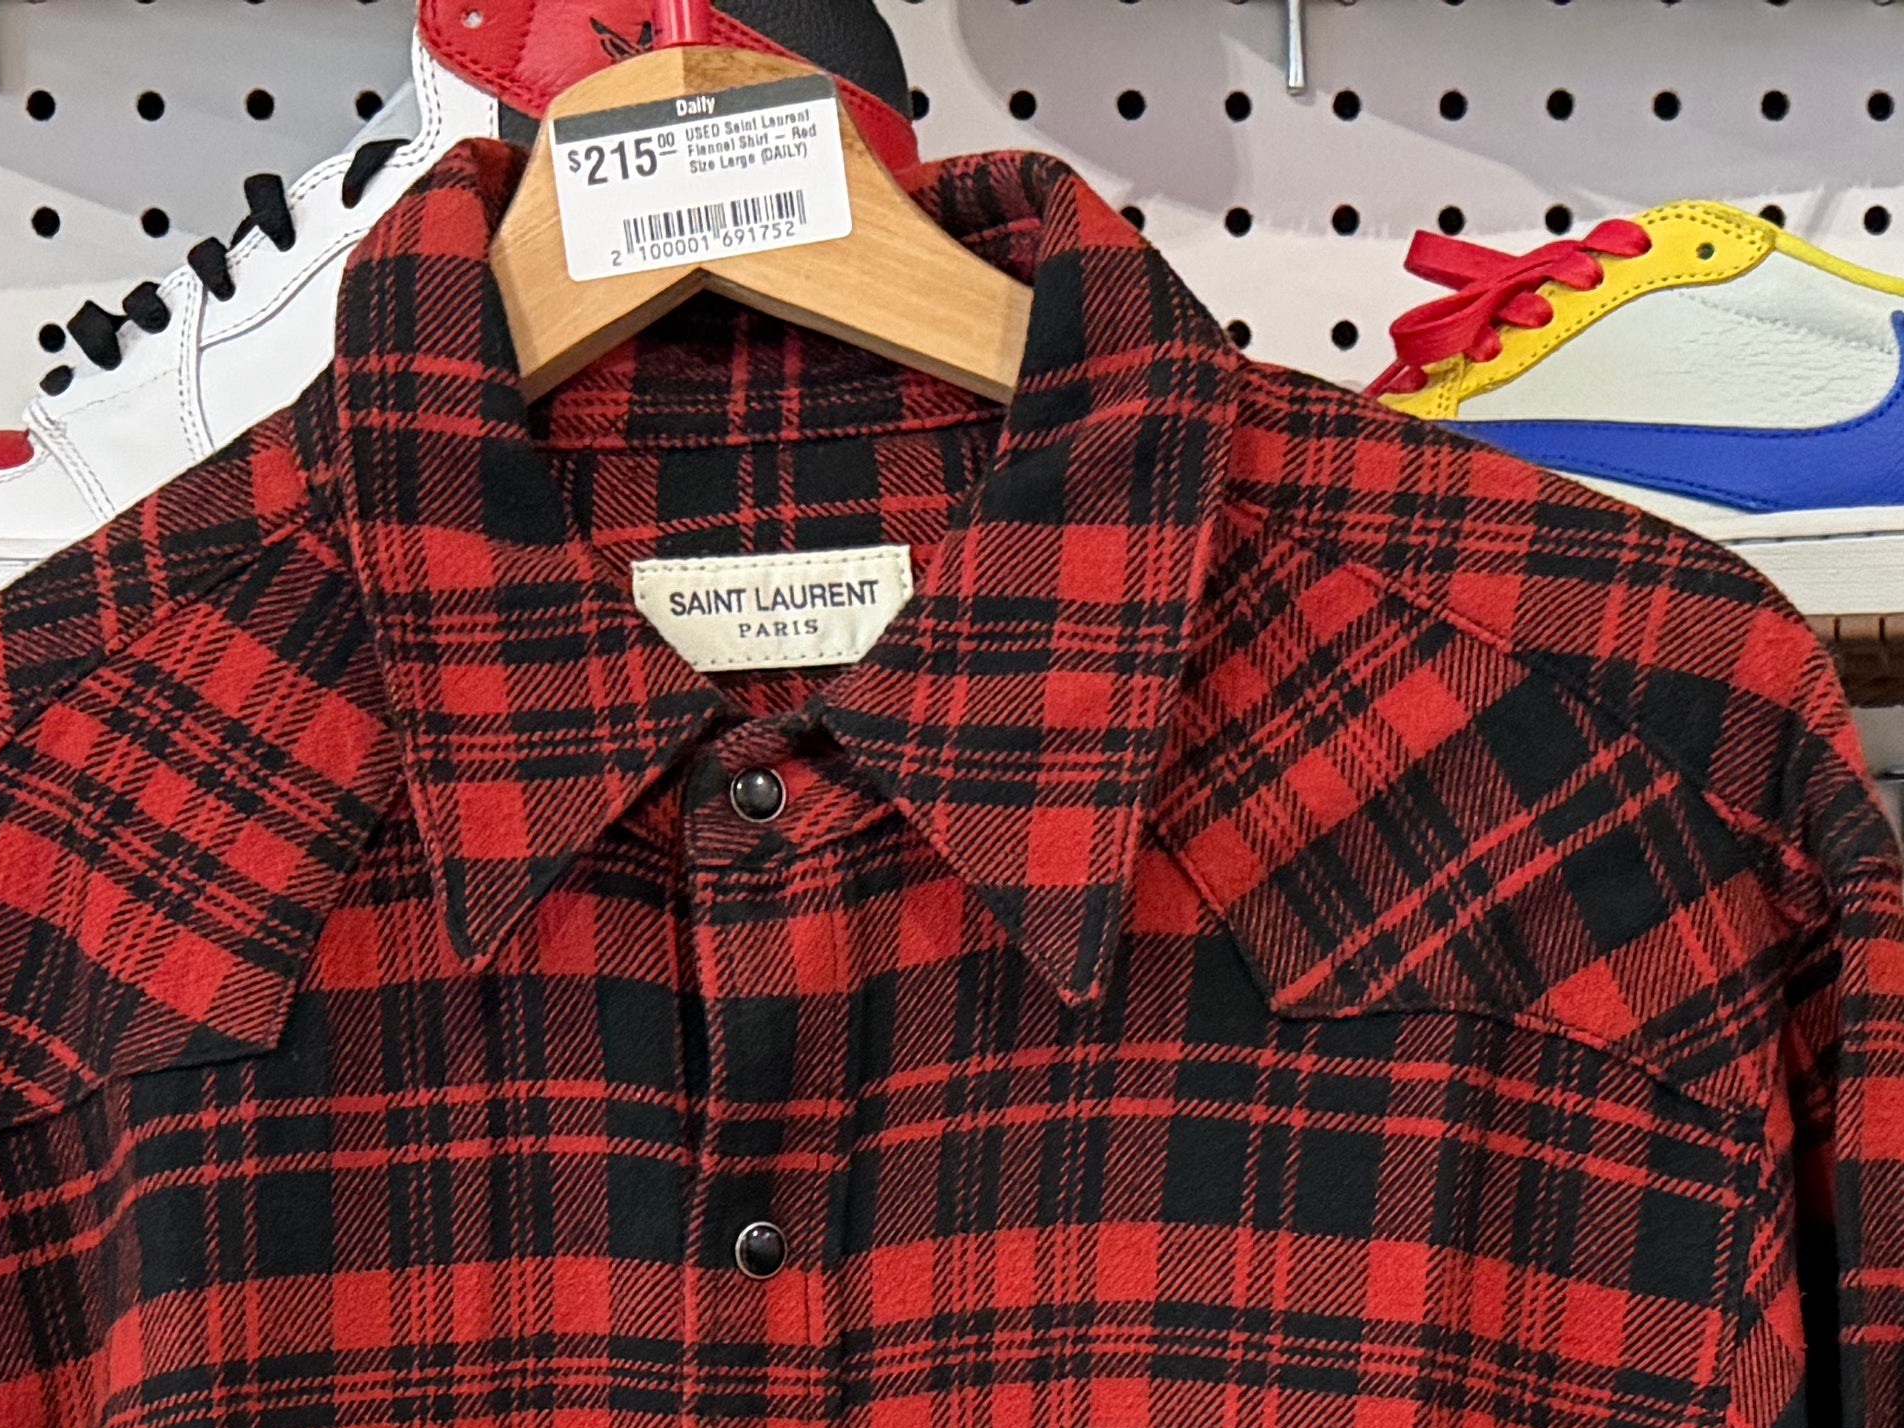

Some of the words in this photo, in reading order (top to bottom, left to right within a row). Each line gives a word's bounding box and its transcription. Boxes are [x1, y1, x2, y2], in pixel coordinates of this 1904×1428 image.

[676, 96, 715, 117] Daily
[685, 126, 720, 143] USED
[724, 117, 758, 134] Saint
[760, 108, 810, 128] Laurent
[687, 139, 735, 157] Flannel
[739, 133, 769, 150] Shirt
[791, 123, 817, 141] Red
[689, 159, 715, 174] Size
[720, 153, 756, 170] Large
[761, 144, 808, 166] (DAILY)
[610, 250, 623, 267] 2
[638, 234, 710, 261] 100001
[722, 220, 796, 249] 691752
[669, 588, 747, 616] SAINT
[755, 579, 879, 612] LAURENT
[738, 618, 820, 638] PARIS
